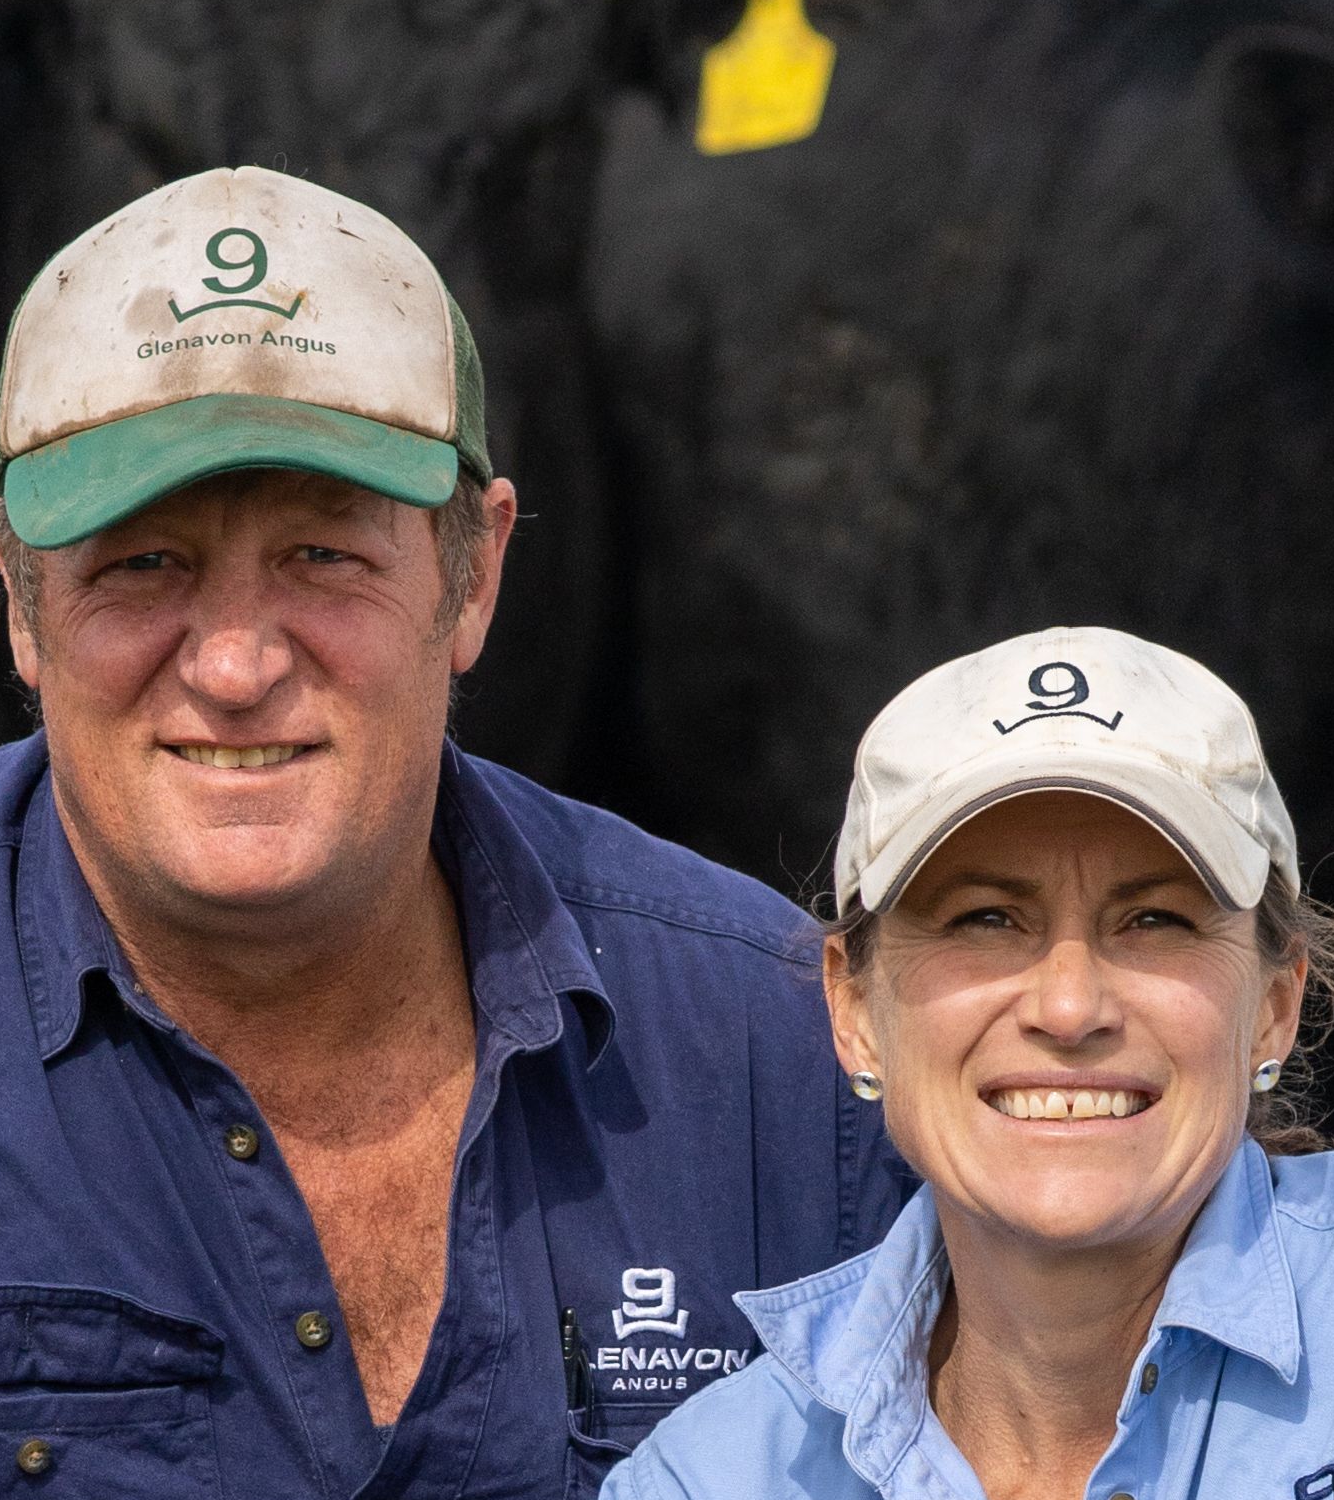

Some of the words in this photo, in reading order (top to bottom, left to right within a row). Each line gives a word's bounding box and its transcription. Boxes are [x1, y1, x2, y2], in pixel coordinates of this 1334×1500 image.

[201, 227, 268, 294] 9
[137, 331, 251, 359] Glenavon
[260, 330, 337, 355] Angus
[1026, 661, 1090, 711] 9
[622, 1267, 676, 1319] 9
[589, 1346, 750, 1375] ENAVON
[612, 1376, 688, 1391] ANGUS
